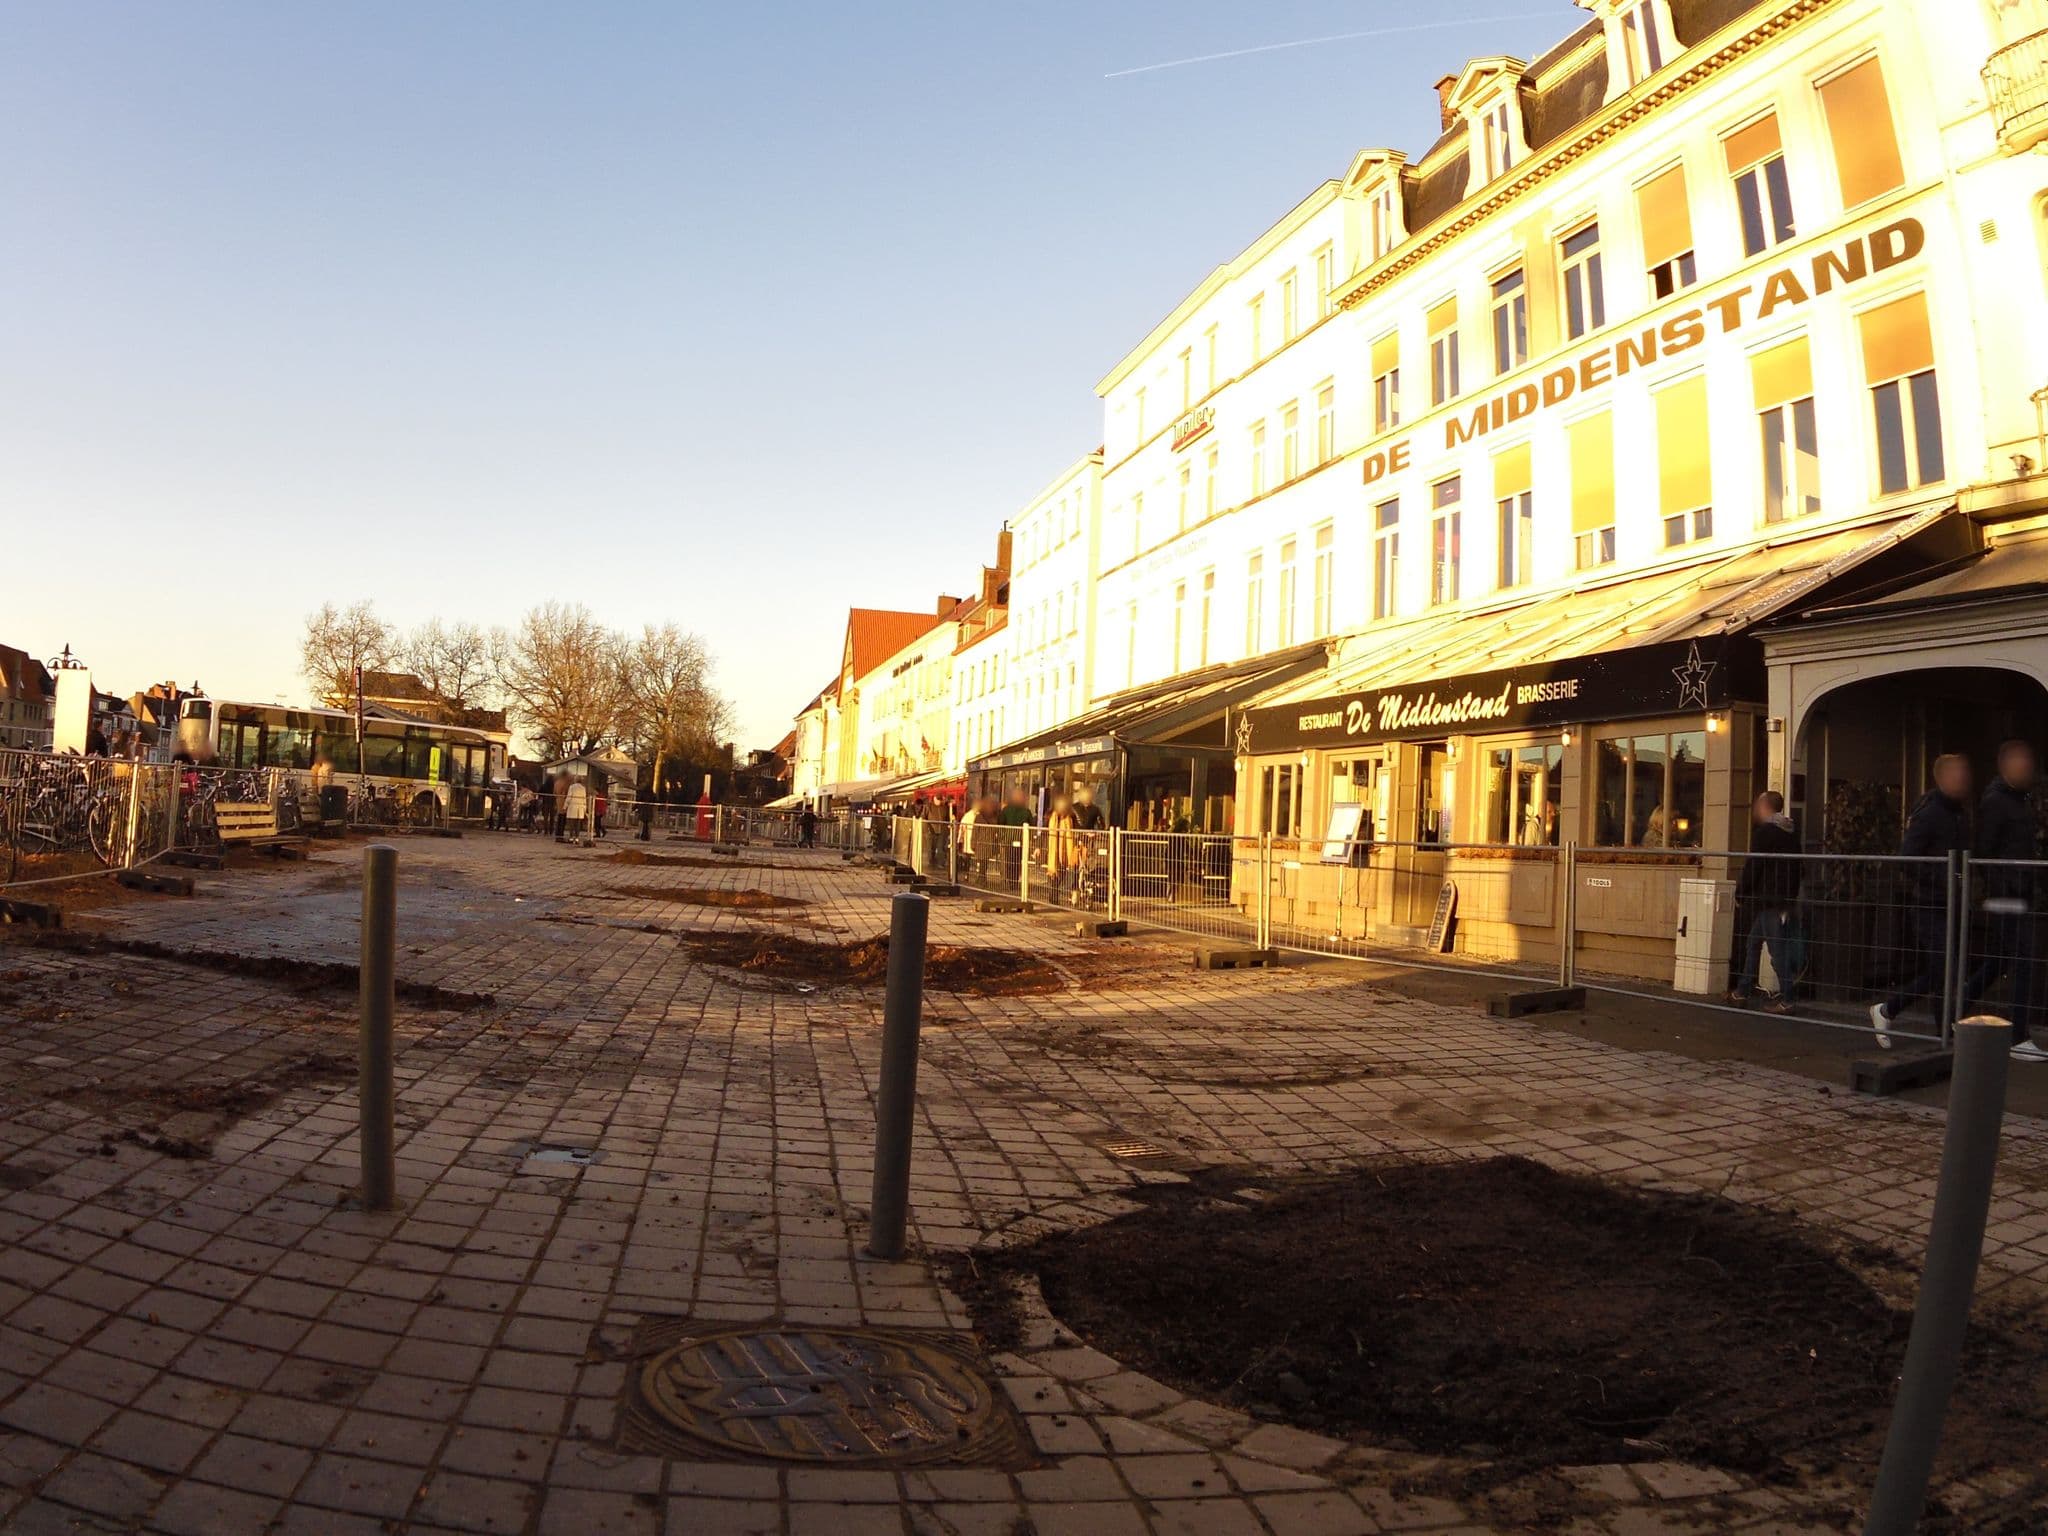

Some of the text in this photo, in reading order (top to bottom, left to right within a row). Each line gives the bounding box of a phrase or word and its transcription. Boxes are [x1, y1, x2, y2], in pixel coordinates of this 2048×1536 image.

[1363, 217, 1925, 485] DE MIDDENSTAND
[1299, 679, 1578, 735] RESTAURANT De Middenstand BRASSERIE
